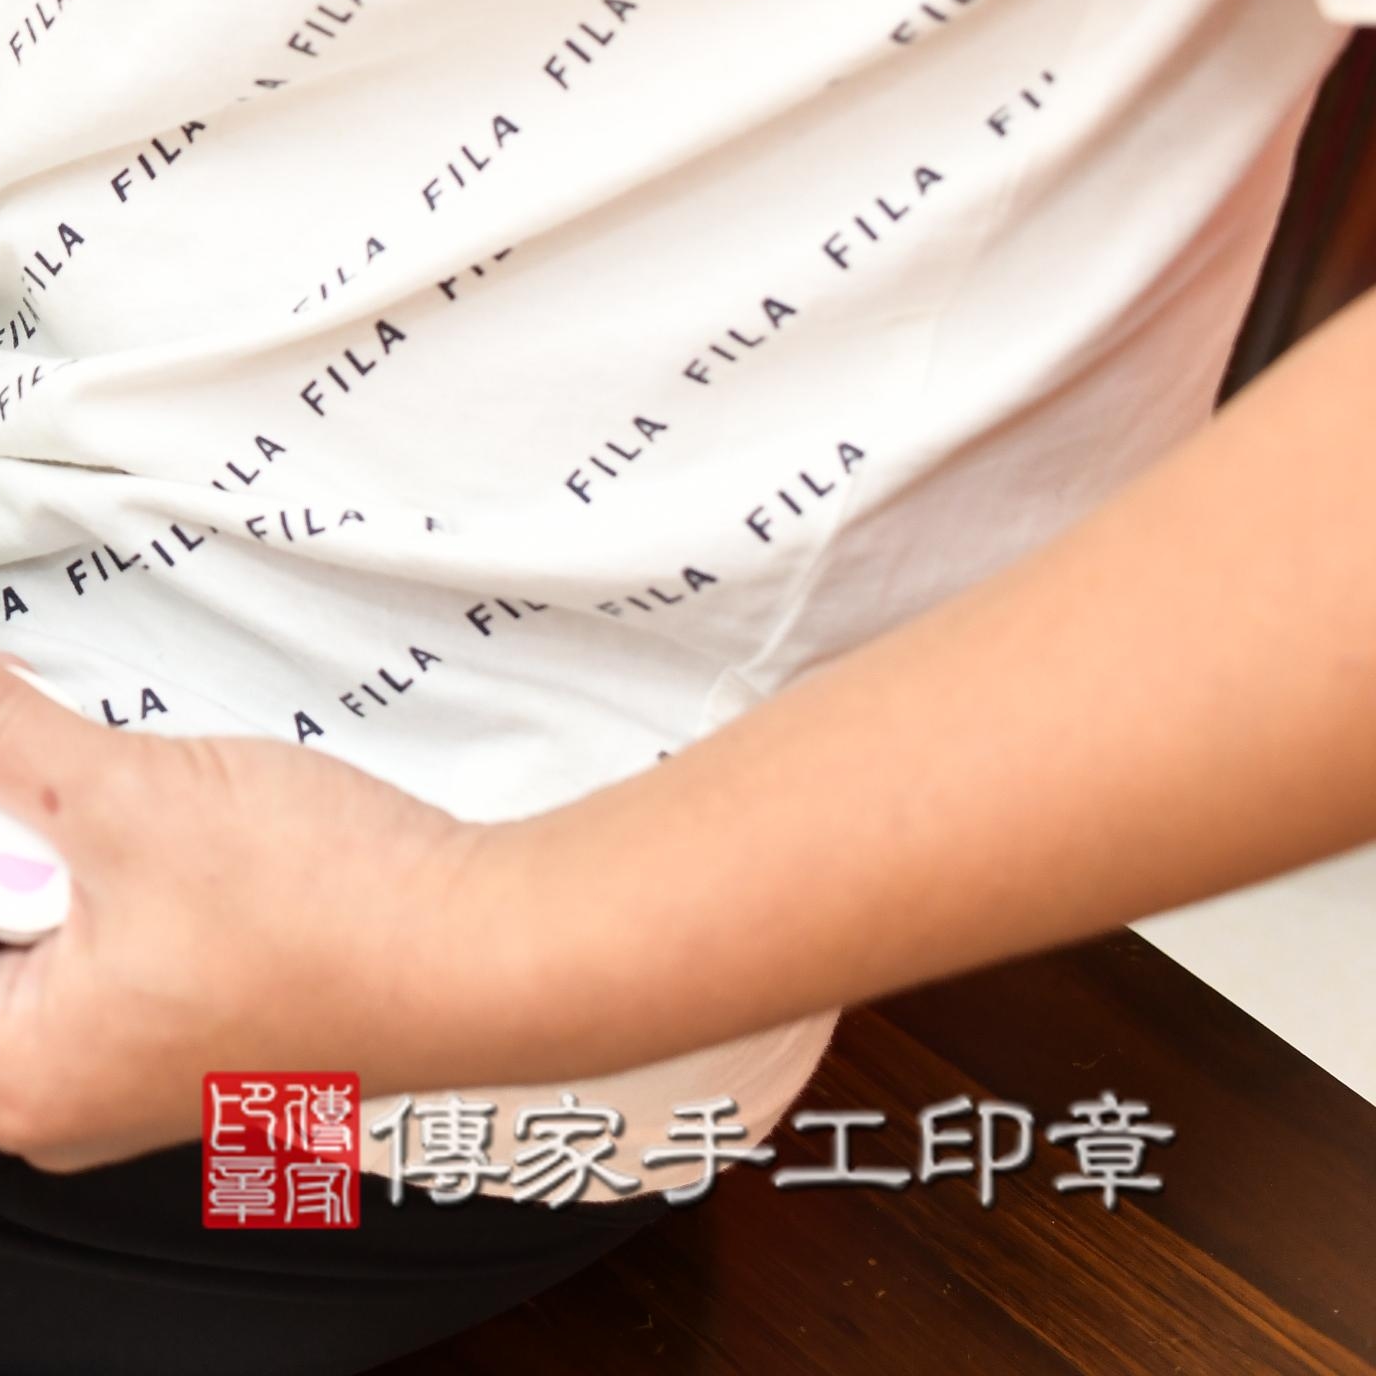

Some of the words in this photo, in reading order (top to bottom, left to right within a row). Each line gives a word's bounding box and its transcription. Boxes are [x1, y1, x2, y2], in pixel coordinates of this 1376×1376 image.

[22, 221, 84, 291] ILA
[421, 114, 521, 212] FILA
[66, 545, 141, 595] FIL
[299, 319, 407, 416] FILA
[564, 415, 669, 504] FILA
[681, 296, 798, 386] FILA
[821, 165, 944, 271] FILA
[338, 646, 443, 719] FILA
[596, 566, 719, 617] FILA
[745, 441, 866, 544] FILA
